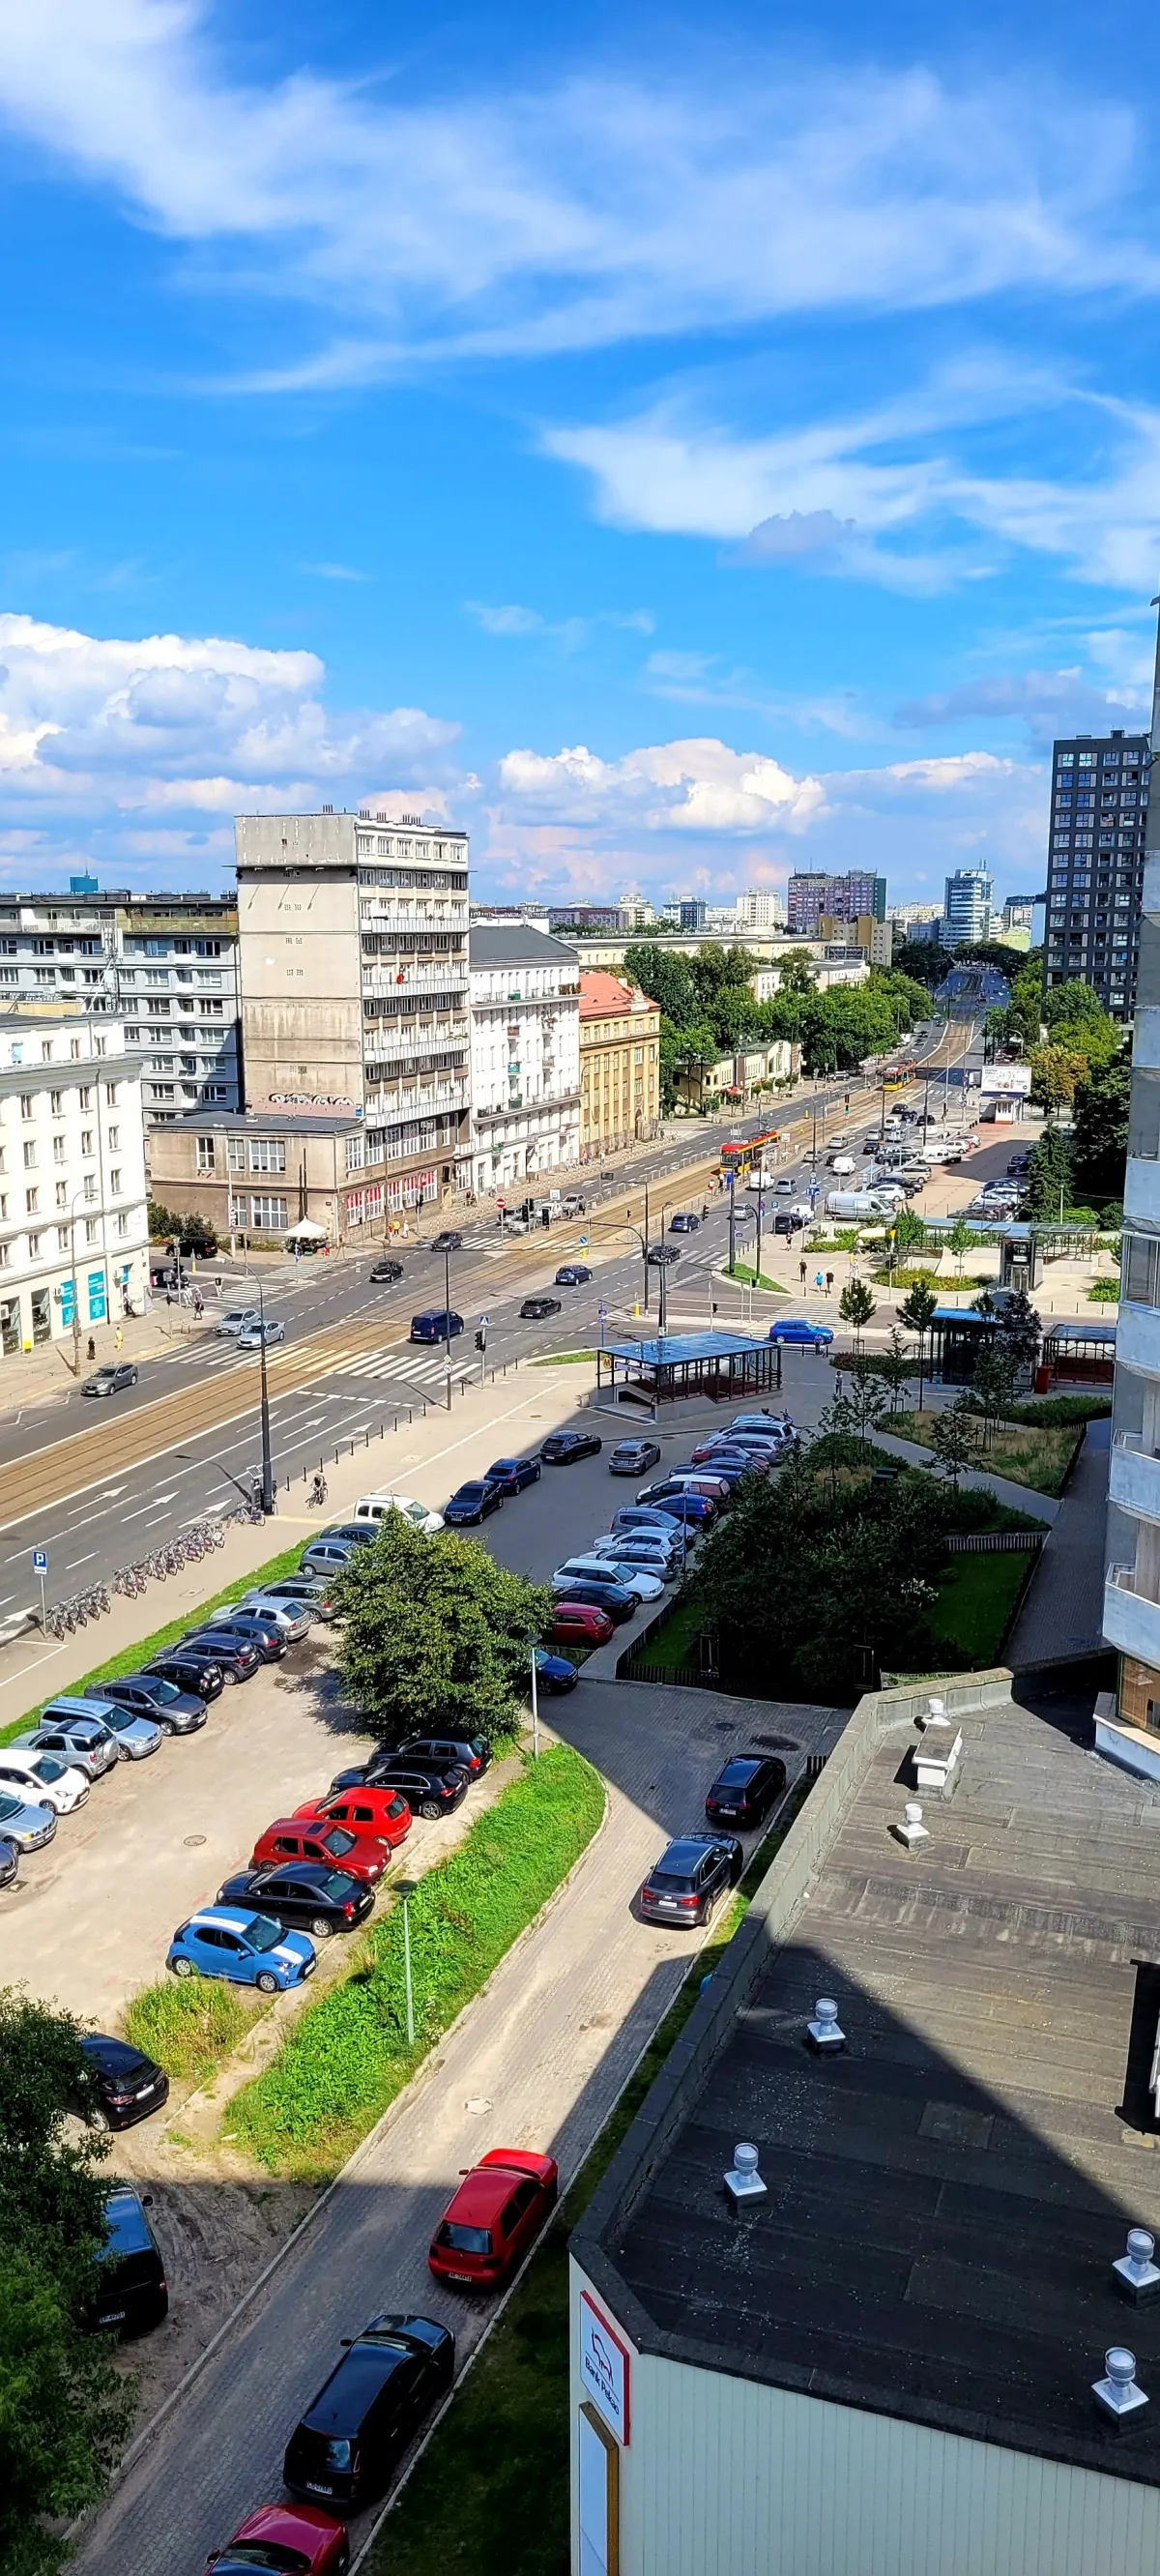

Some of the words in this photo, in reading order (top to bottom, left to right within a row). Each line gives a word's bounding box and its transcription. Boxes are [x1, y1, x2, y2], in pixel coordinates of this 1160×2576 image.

[36, 1553, 44, 1566] P
[585, 2356, 600, 2386] Bank
[601, 2380, 620, 2415] Pekao
